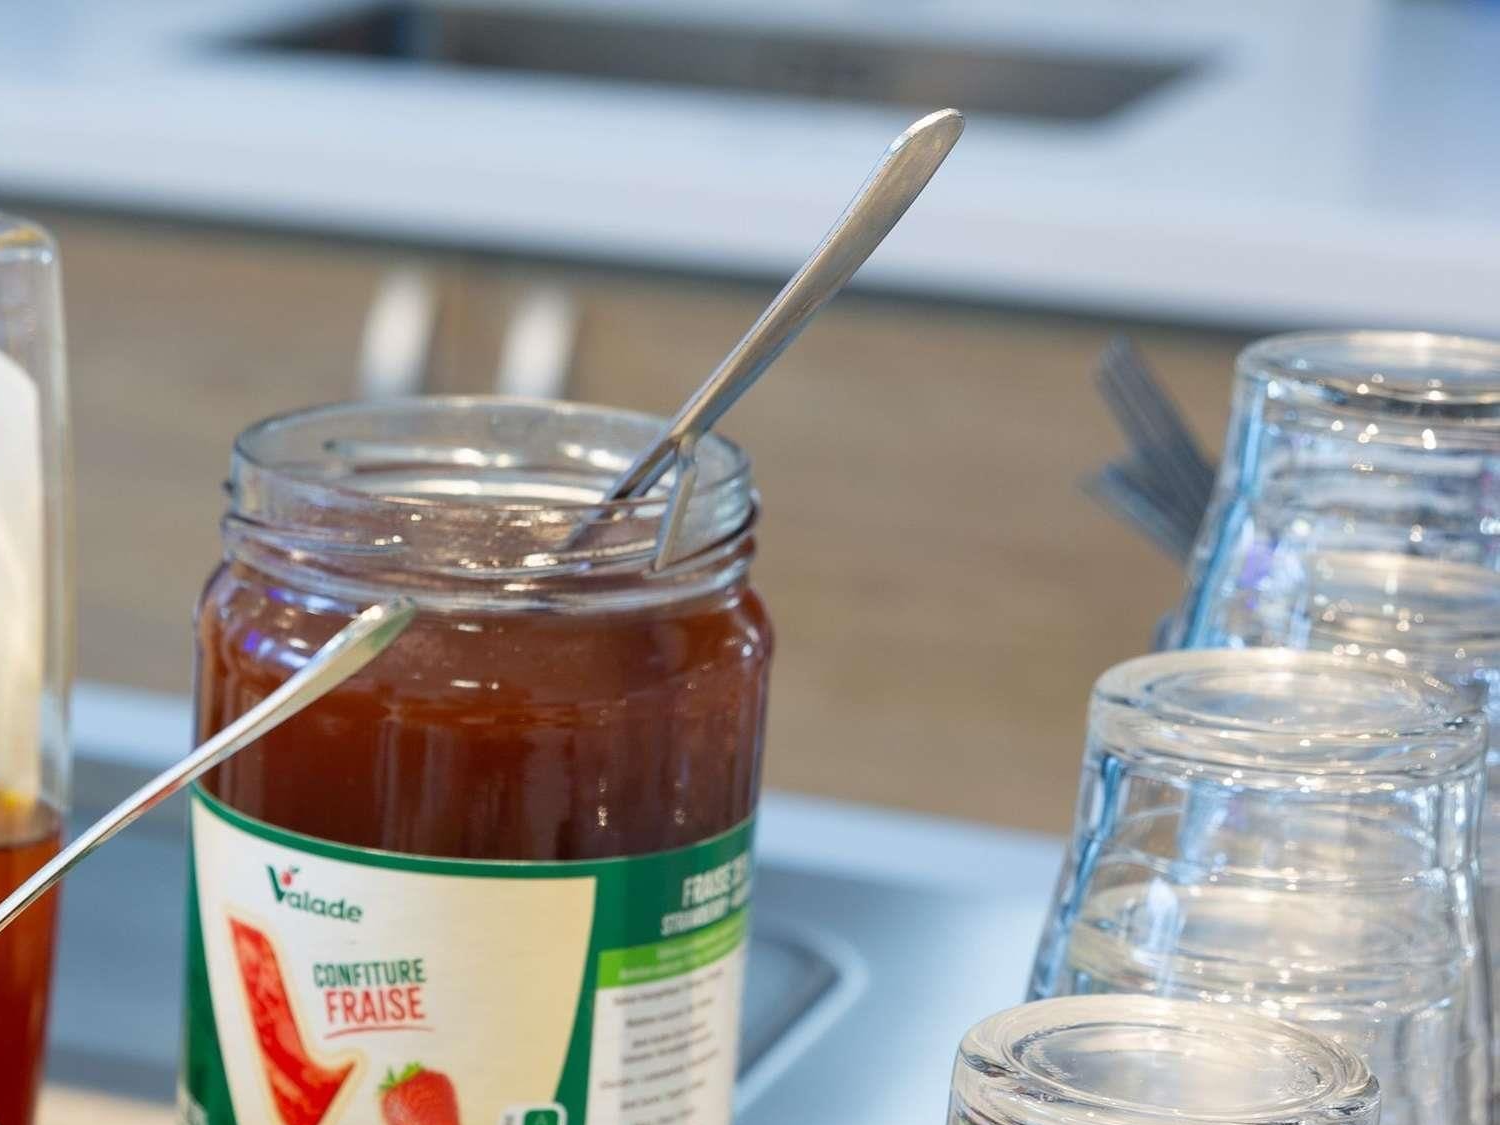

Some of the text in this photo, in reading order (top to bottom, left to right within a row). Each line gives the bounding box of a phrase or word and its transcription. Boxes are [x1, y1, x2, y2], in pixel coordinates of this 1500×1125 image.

[266, 865, 363, 923] Valade
[313, 958, 427, 988] CONFITURE
[325, 986, 426, 1024] FRAISE
